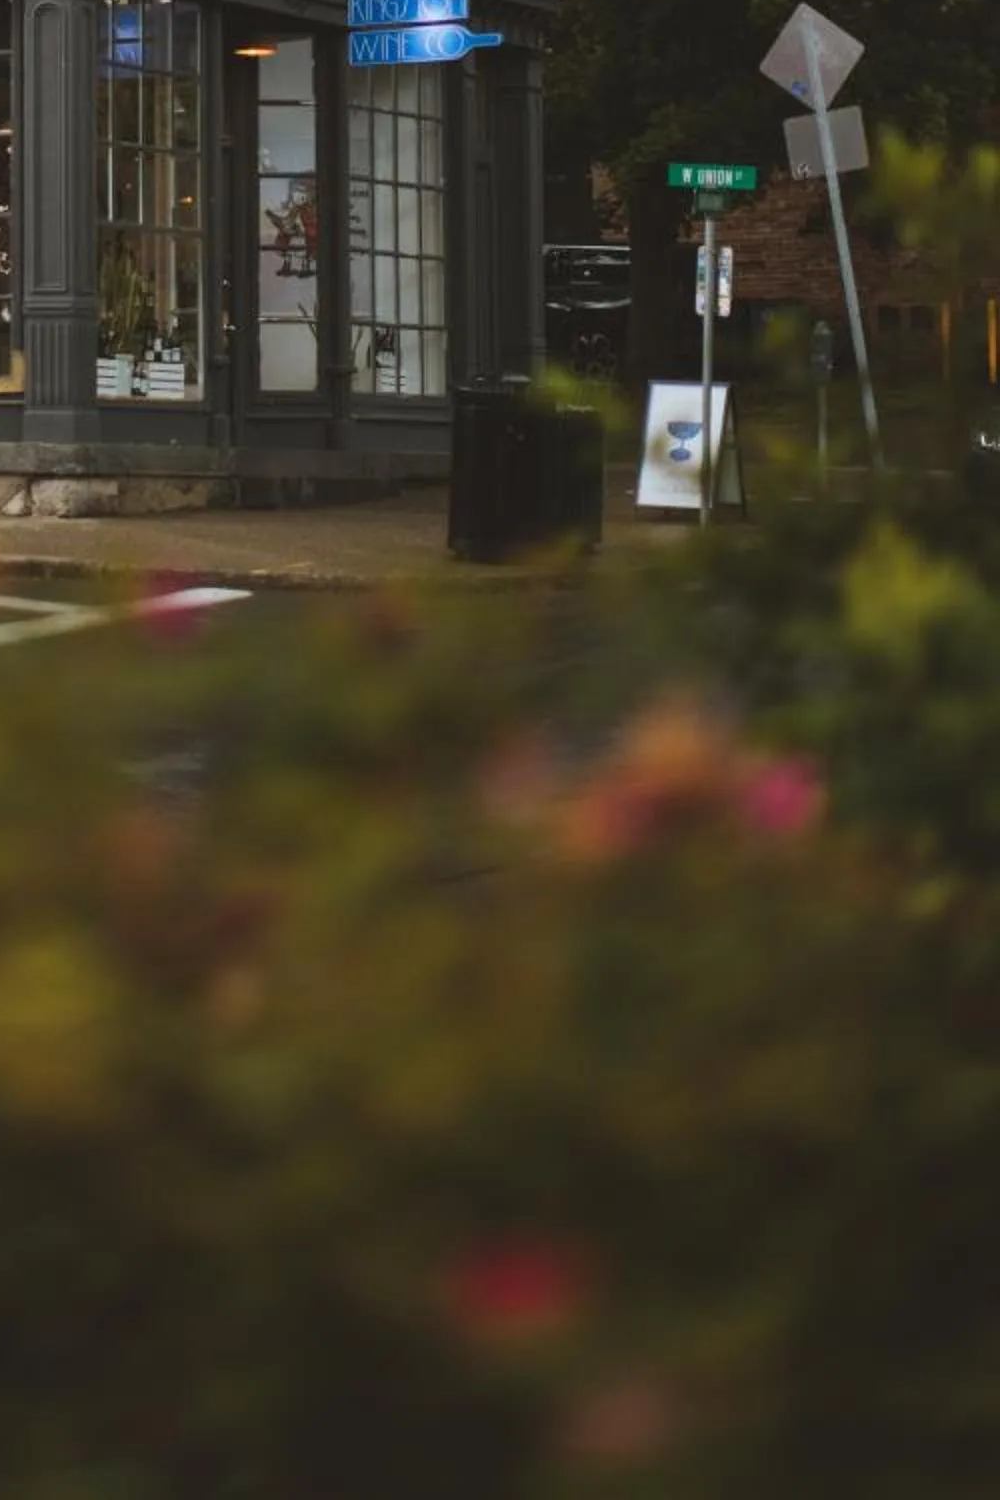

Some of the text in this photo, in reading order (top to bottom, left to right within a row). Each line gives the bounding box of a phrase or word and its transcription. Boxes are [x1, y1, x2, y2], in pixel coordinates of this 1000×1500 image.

[352, 29, 465, 60] WINE CO
[682, 167, 693, 184] W
[697, 168, 733, 187] UNION
